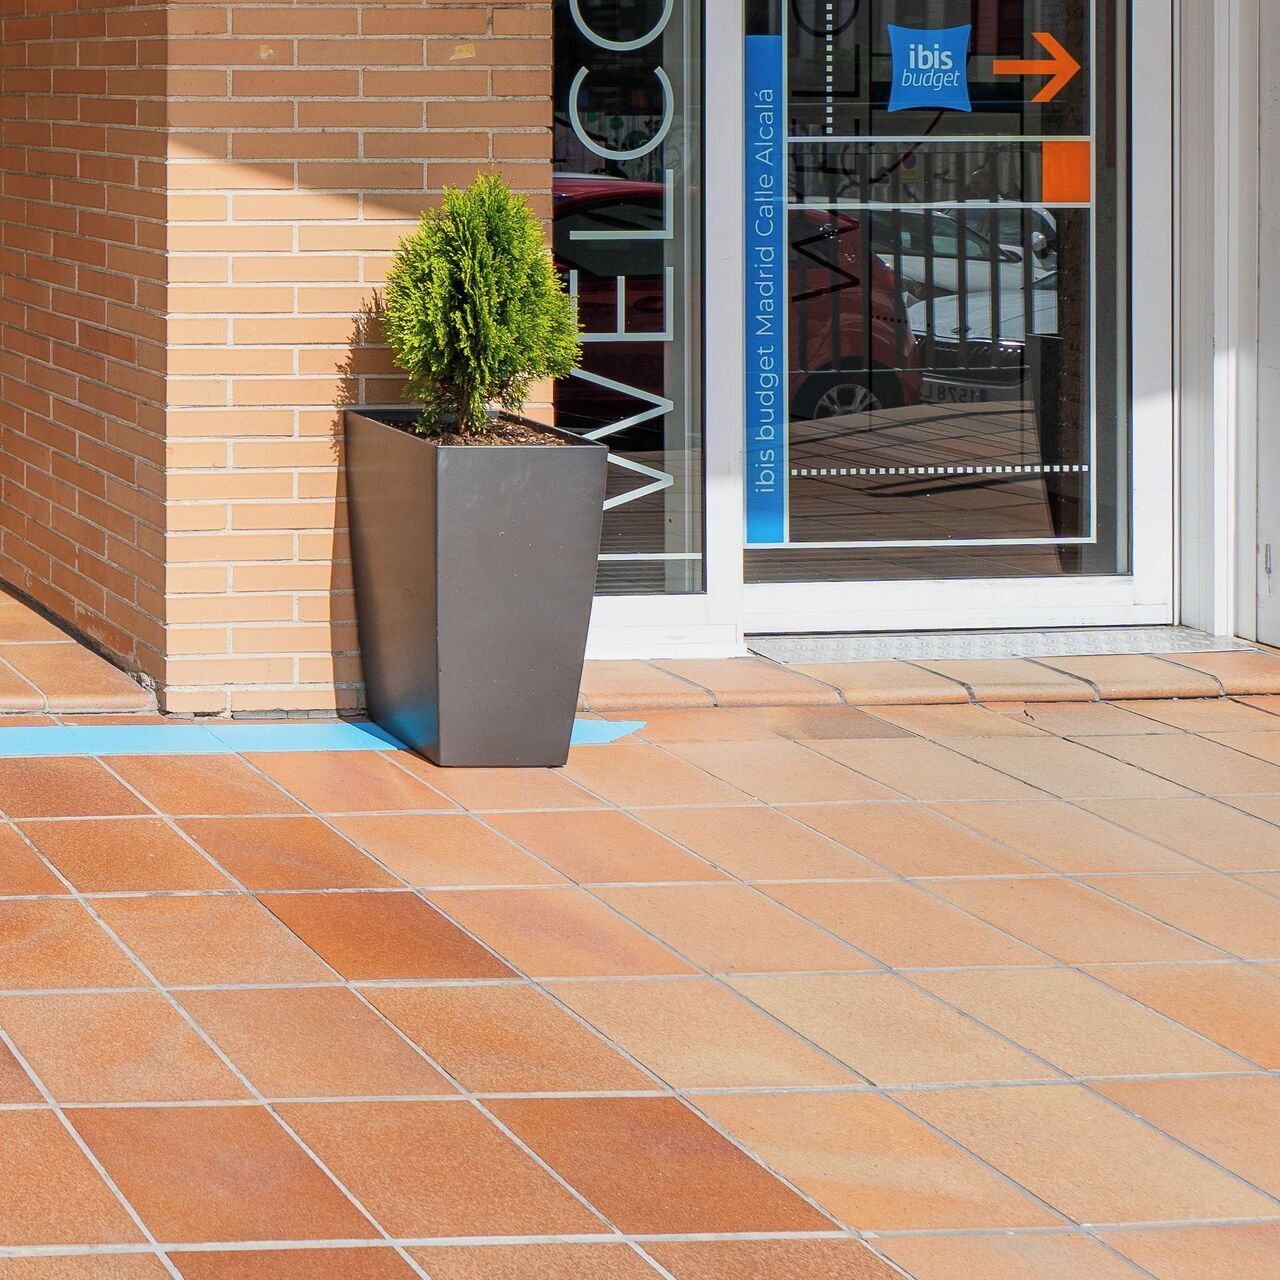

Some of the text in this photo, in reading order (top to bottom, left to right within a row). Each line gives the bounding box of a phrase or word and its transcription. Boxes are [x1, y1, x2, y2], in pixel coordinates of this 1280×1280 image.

[909, 43, 953, 70] ibis
[901, 69, 961, 91] budget
[753, 88, 780, 493] ibis budget Madrid Calle Alcalá
